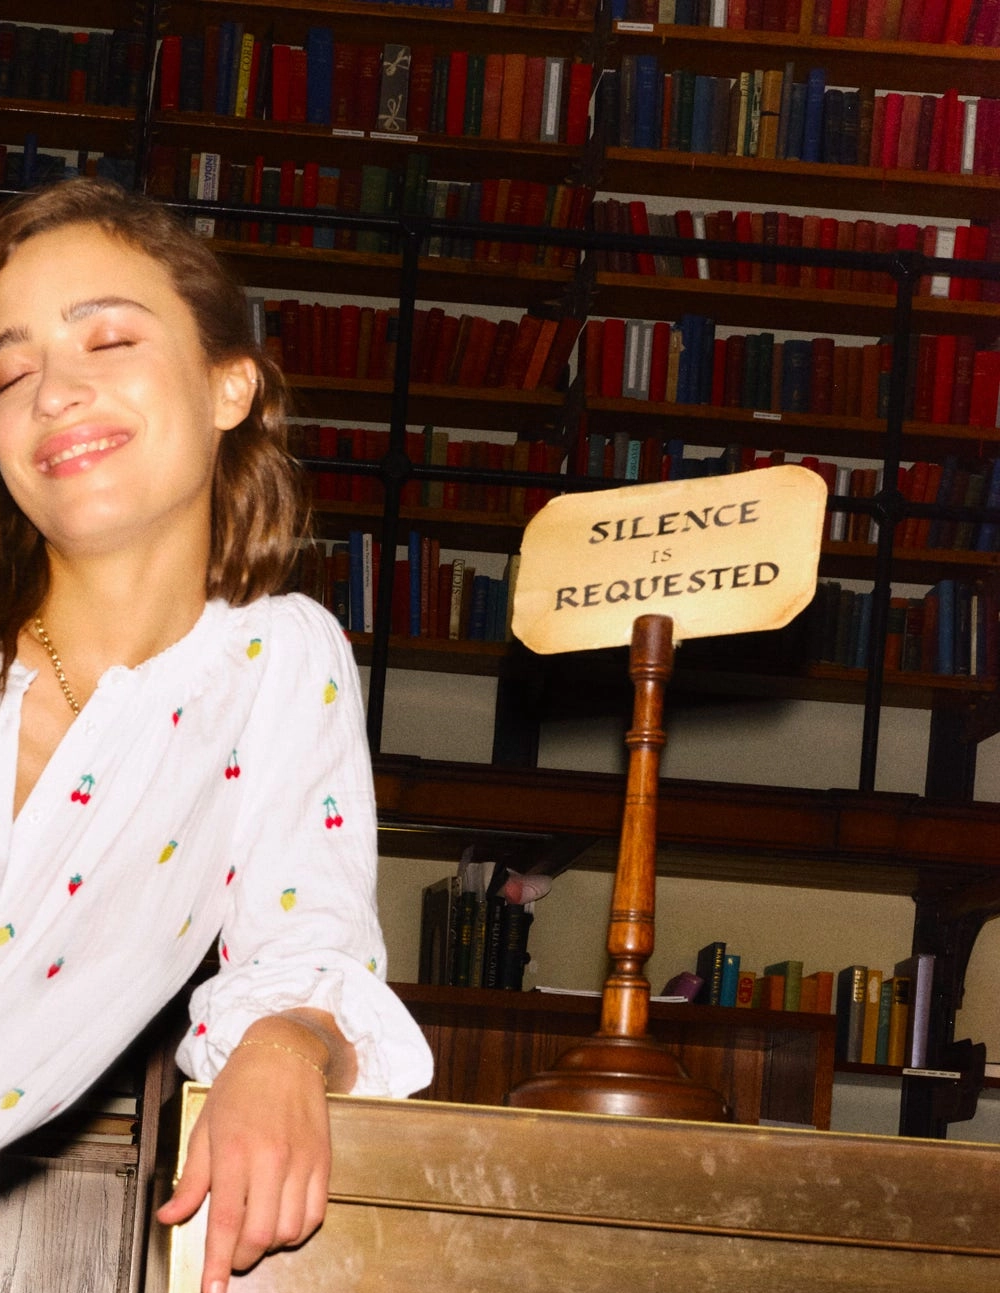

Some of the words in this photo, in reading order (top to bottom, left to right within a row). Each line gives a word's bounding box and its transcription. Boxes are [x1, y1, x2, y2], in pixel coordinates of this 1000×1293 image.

[204, 155, 214, 182] INDIA
[588, 499, 761, 545] SILENCE
[650, 547, 673, 564] IS
[453, 560, 464, 599] SICILY
[554, 561, 780, 611] REQUESTED
